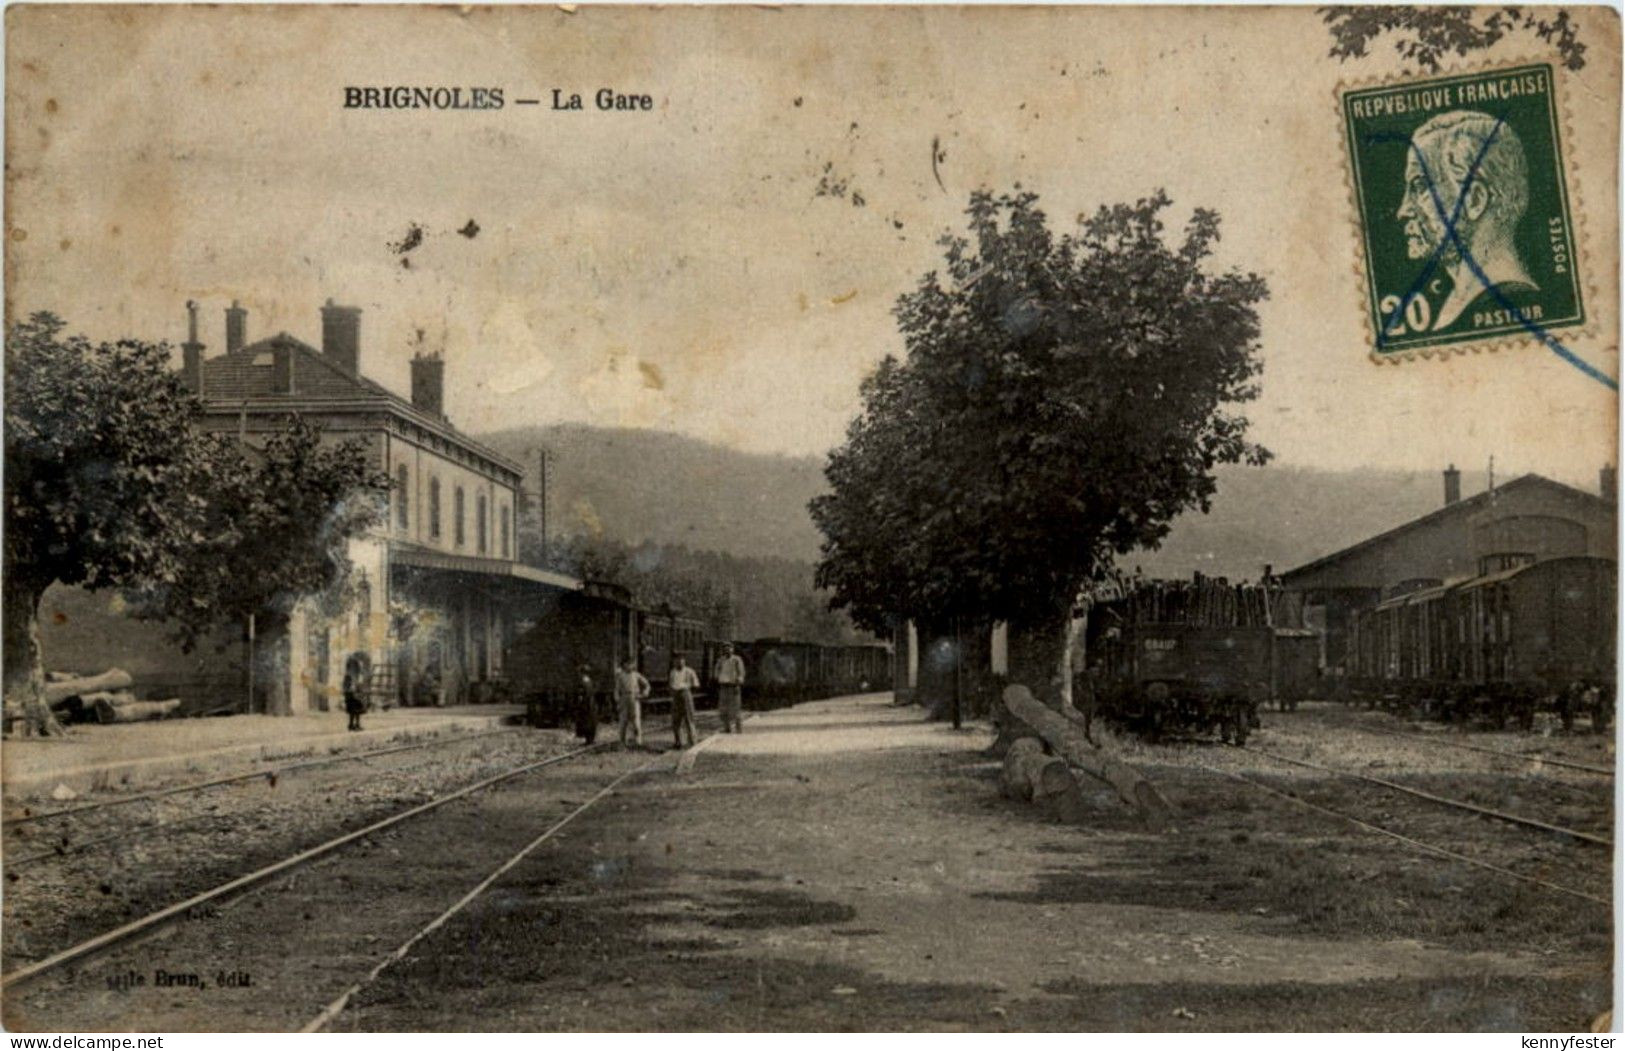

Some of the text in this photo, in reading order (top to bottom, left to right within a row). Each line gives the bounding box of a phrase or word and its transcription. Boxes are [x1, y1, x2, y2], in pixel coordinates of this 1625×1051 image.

[1458, 73, 1546, 103] FRANÇAISE
[1549, 216, 1566, 274] POSTES
[1380, 291, 1431, 337] 20
